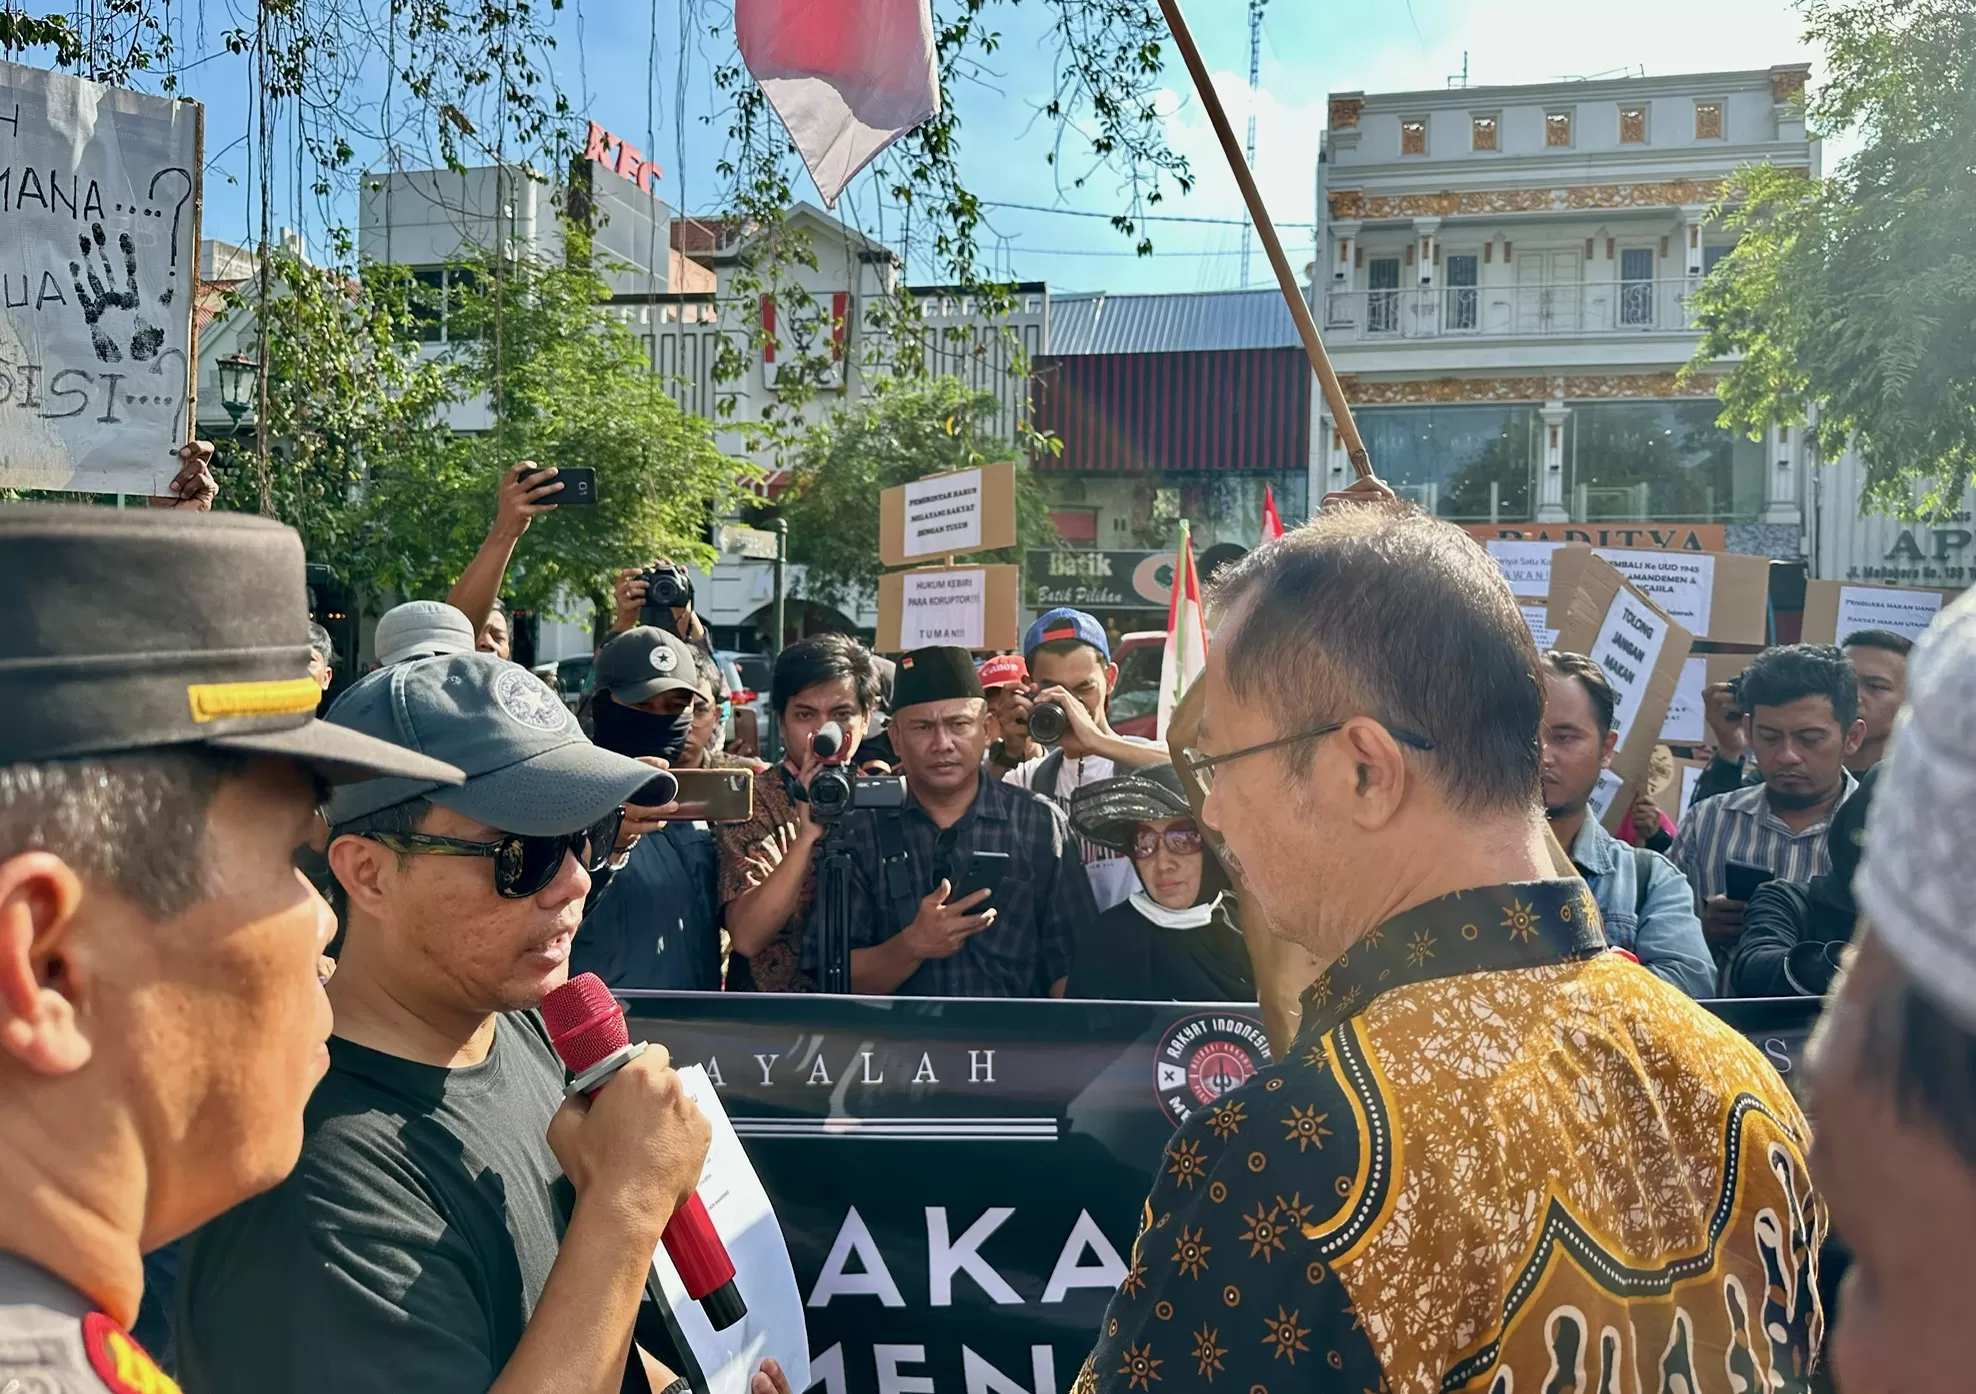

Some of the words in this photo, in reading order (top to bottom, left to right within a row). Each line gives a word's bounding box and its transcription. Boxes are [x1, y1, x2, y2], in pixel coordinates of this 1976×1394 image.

[584, 120, 663, 199] KFC
[909, 491, 952, 507] PEMERINTAH
[952, 487, 977, 498] HARUS
[910, 509, 946, 522] MELAYANI
[946, 503, 975, 516] RAKYAT
[916, 526, 945, 537] DENGAN
[1884, 529, 1976, 560] AP
[1658, 563, 1678, 572] UUD
[916, 580, 945, 590] HUKUM
[947, 579, 972, 589] KEBIRI
[1038, 585, 1072, 603] Batik
[908, 597, 928, 607] PARA
[1845, 598, 1886, 609] PENGUASA
[1886, 603, 1914, 611] MAKAN
[1622, 606, 1655, 640] TOLONG
[1847, 616, 1876, 624] RAKYAT
[1877, 619, 1904, 627] MAKAN
[1611, 631, 1645, 663] JANGAN
[1603, 653, 1636, 685] MAKAN
[1166, 1020, 1208, 1059] RAKYAT
[806, 1204, 1131, 1308] AKA
